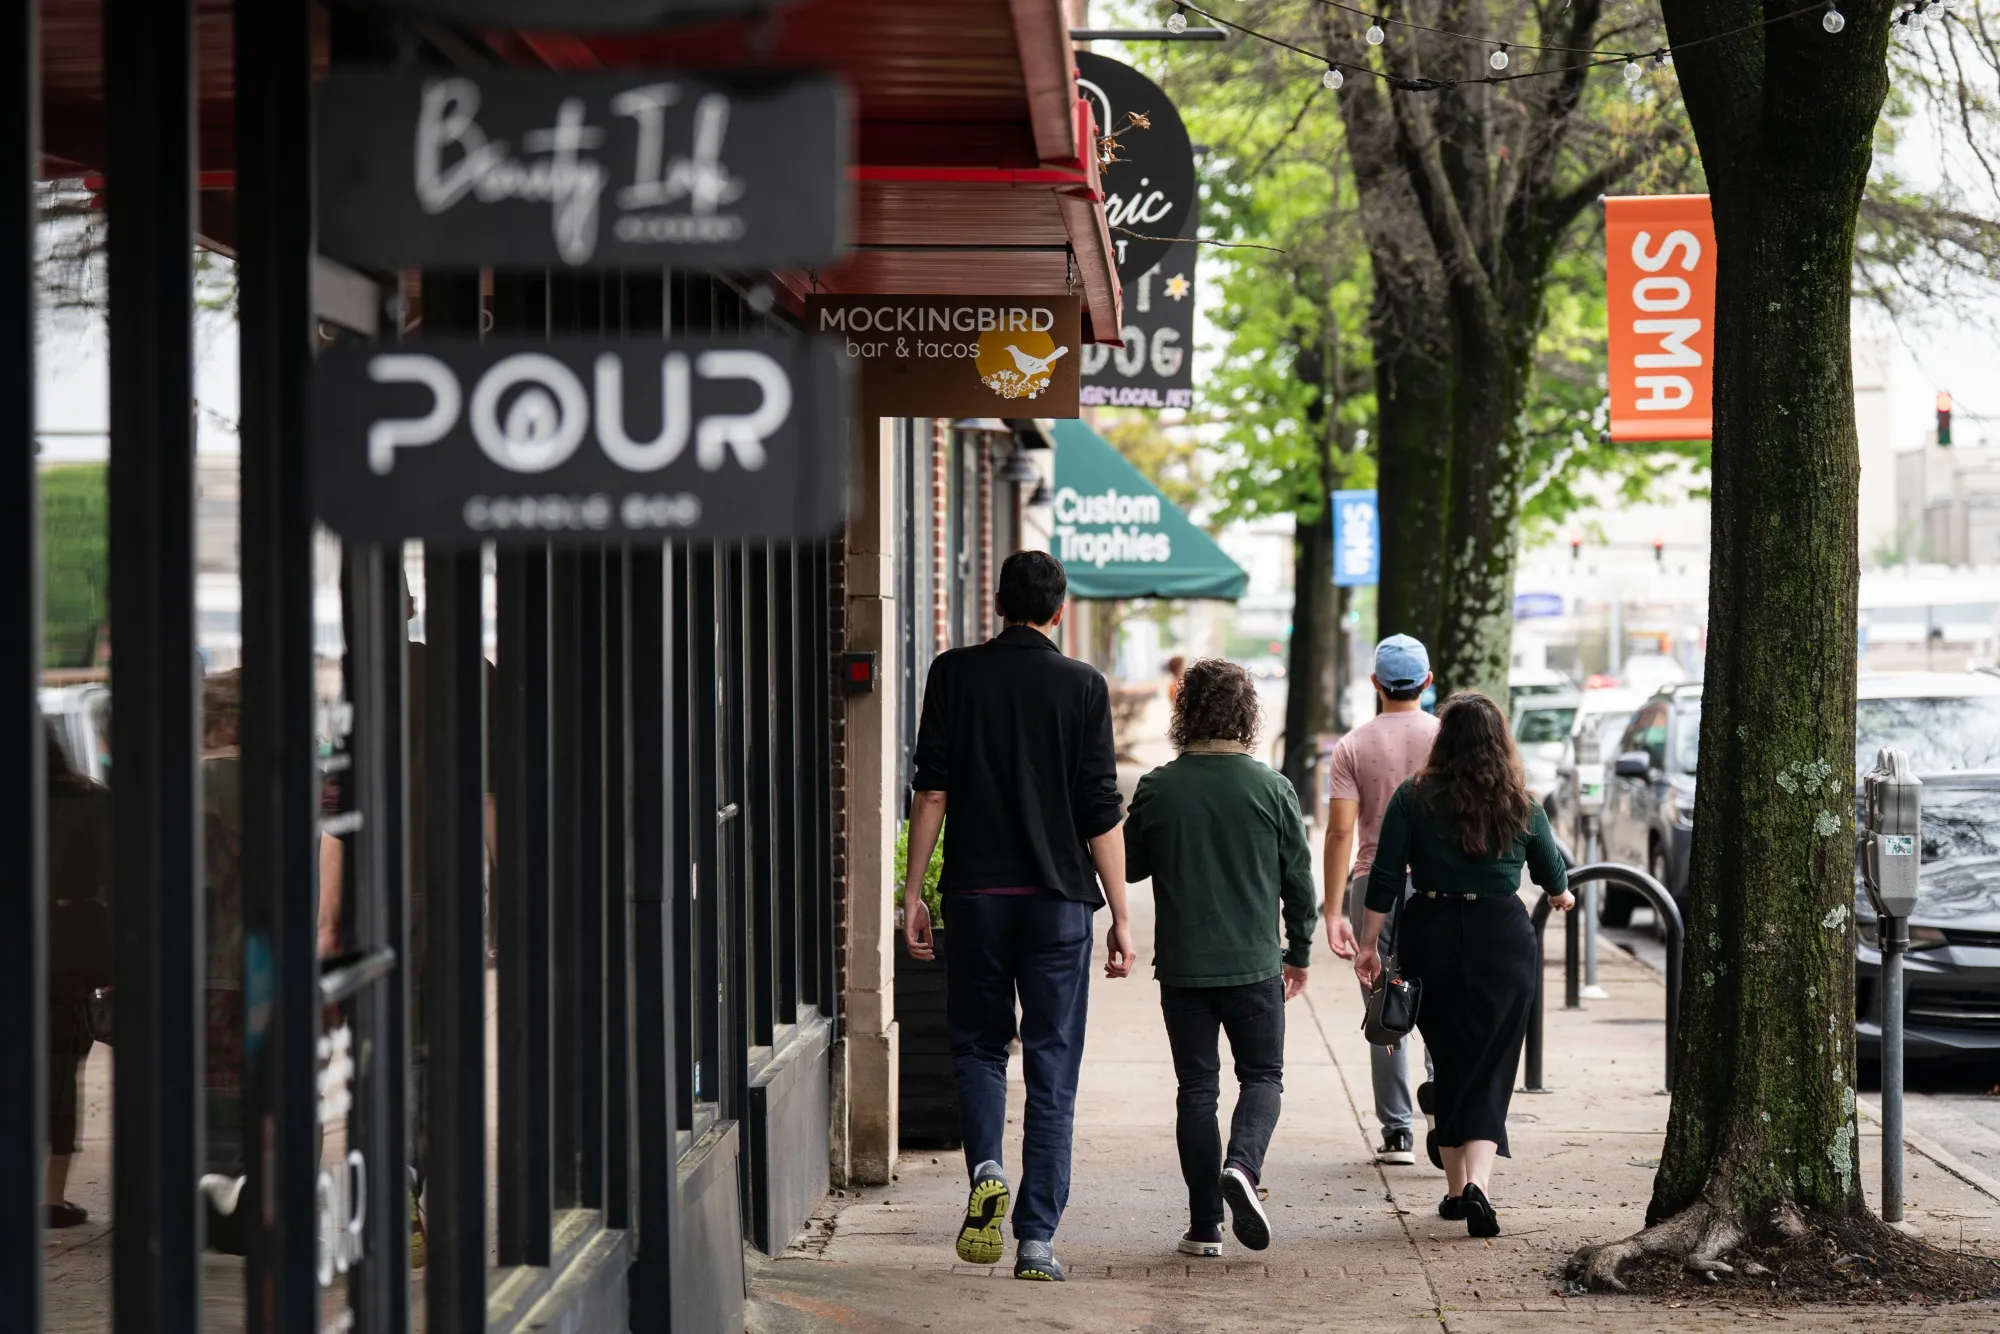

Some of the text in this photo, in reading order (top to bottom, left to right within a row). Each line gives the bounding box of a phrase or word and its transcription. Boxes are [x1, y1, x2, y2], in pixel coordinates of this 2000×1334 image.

[819, 307, 1055, 332] MOCKINGBIRD
[1631, 229, 1702, 411] SOMA
[846, 336, 981, 358] bar & tacos
[367, 349, 793, 476] POUR
[1055, 487, 1160, 525] Custom
[1056, 525, 1171, 569] Trophies
